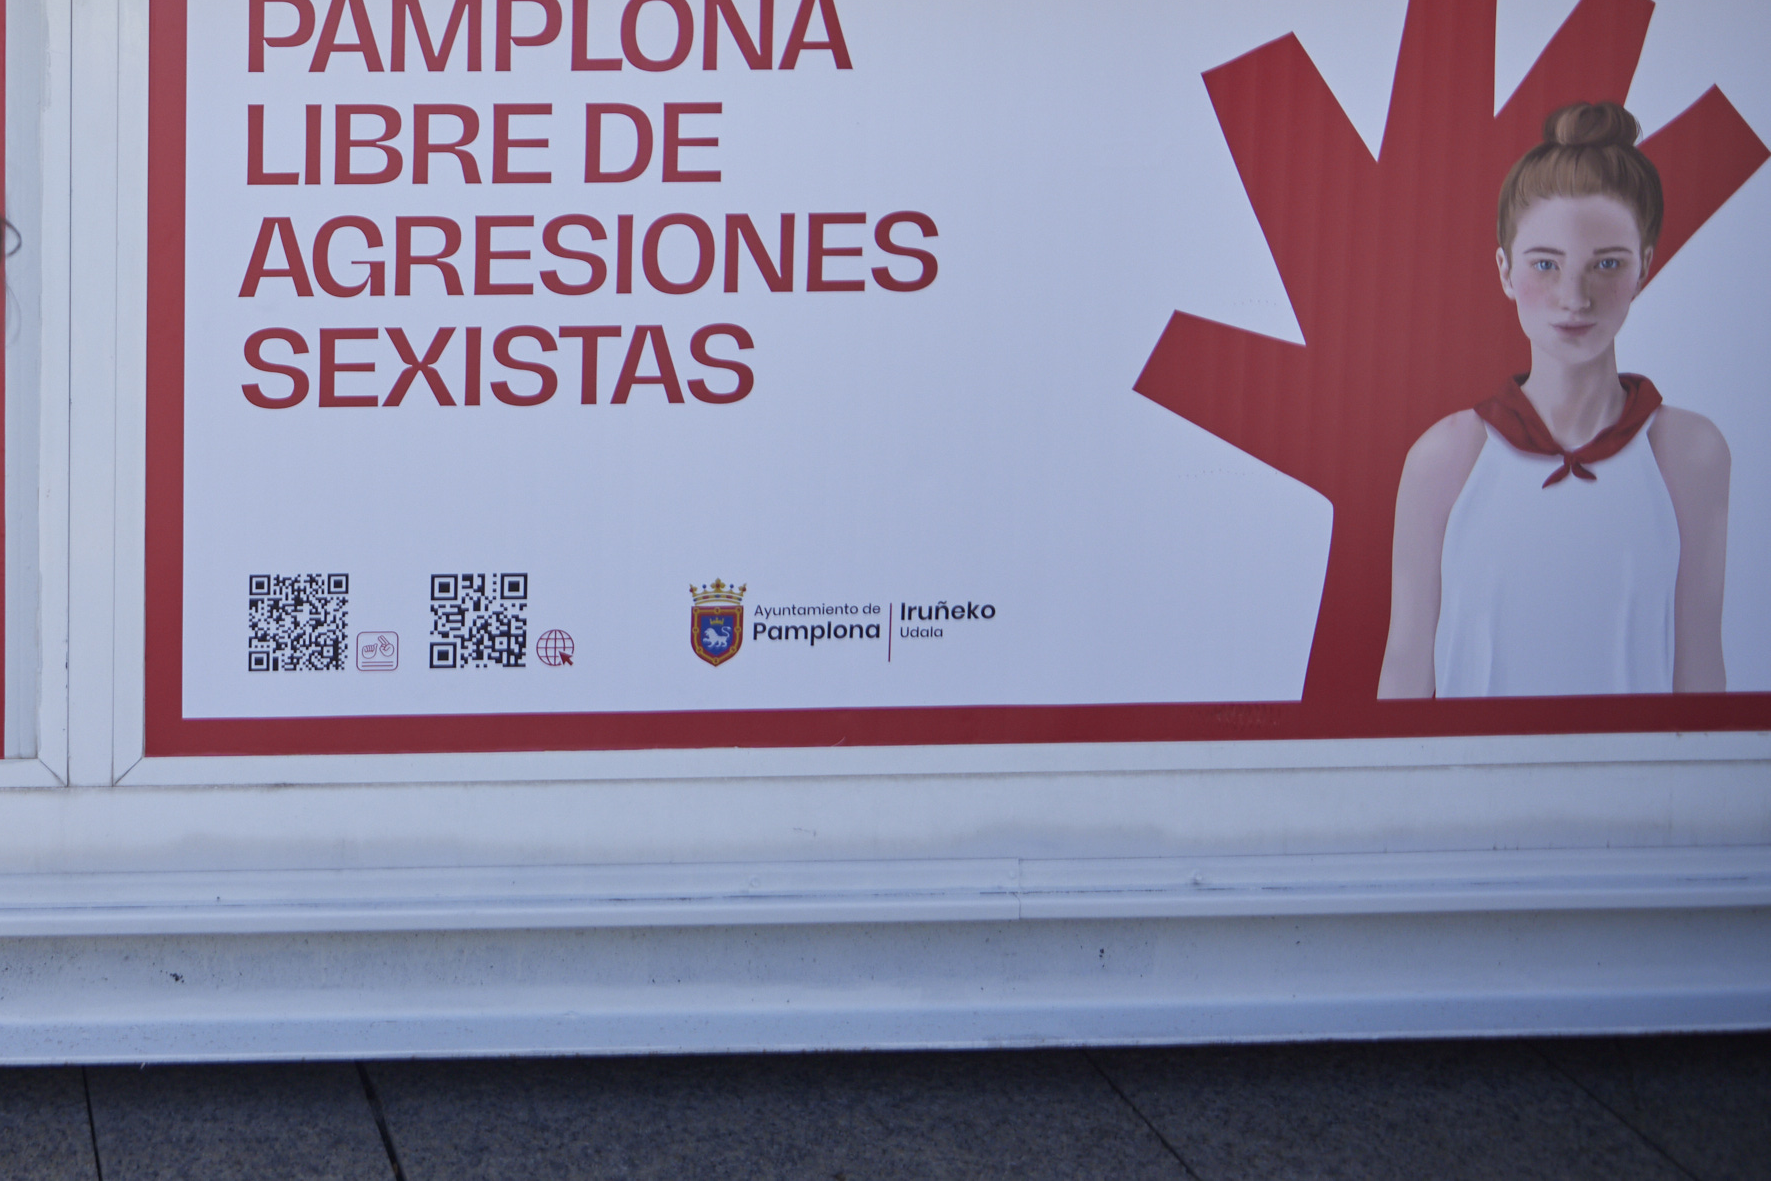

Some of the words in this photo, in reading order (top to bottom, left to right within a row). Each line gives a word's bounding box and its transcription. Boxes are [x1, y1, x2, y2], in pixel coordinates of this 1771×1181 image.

[246, 102, 554, 186] LIBRE
[583, 101, 724, 184] DE
[238, 210, 940, 299] AGRESIONES
[240, 322, 756, 410] SEXISTAS
[753, 603, 860, 618] Ayuntamiento
[861, 603, 882, 616] de
[899, 600, 997, 621] Iruñeko
[752, 621, 881, 647] Pamplona
[899, 626, 944, 638] Udala
